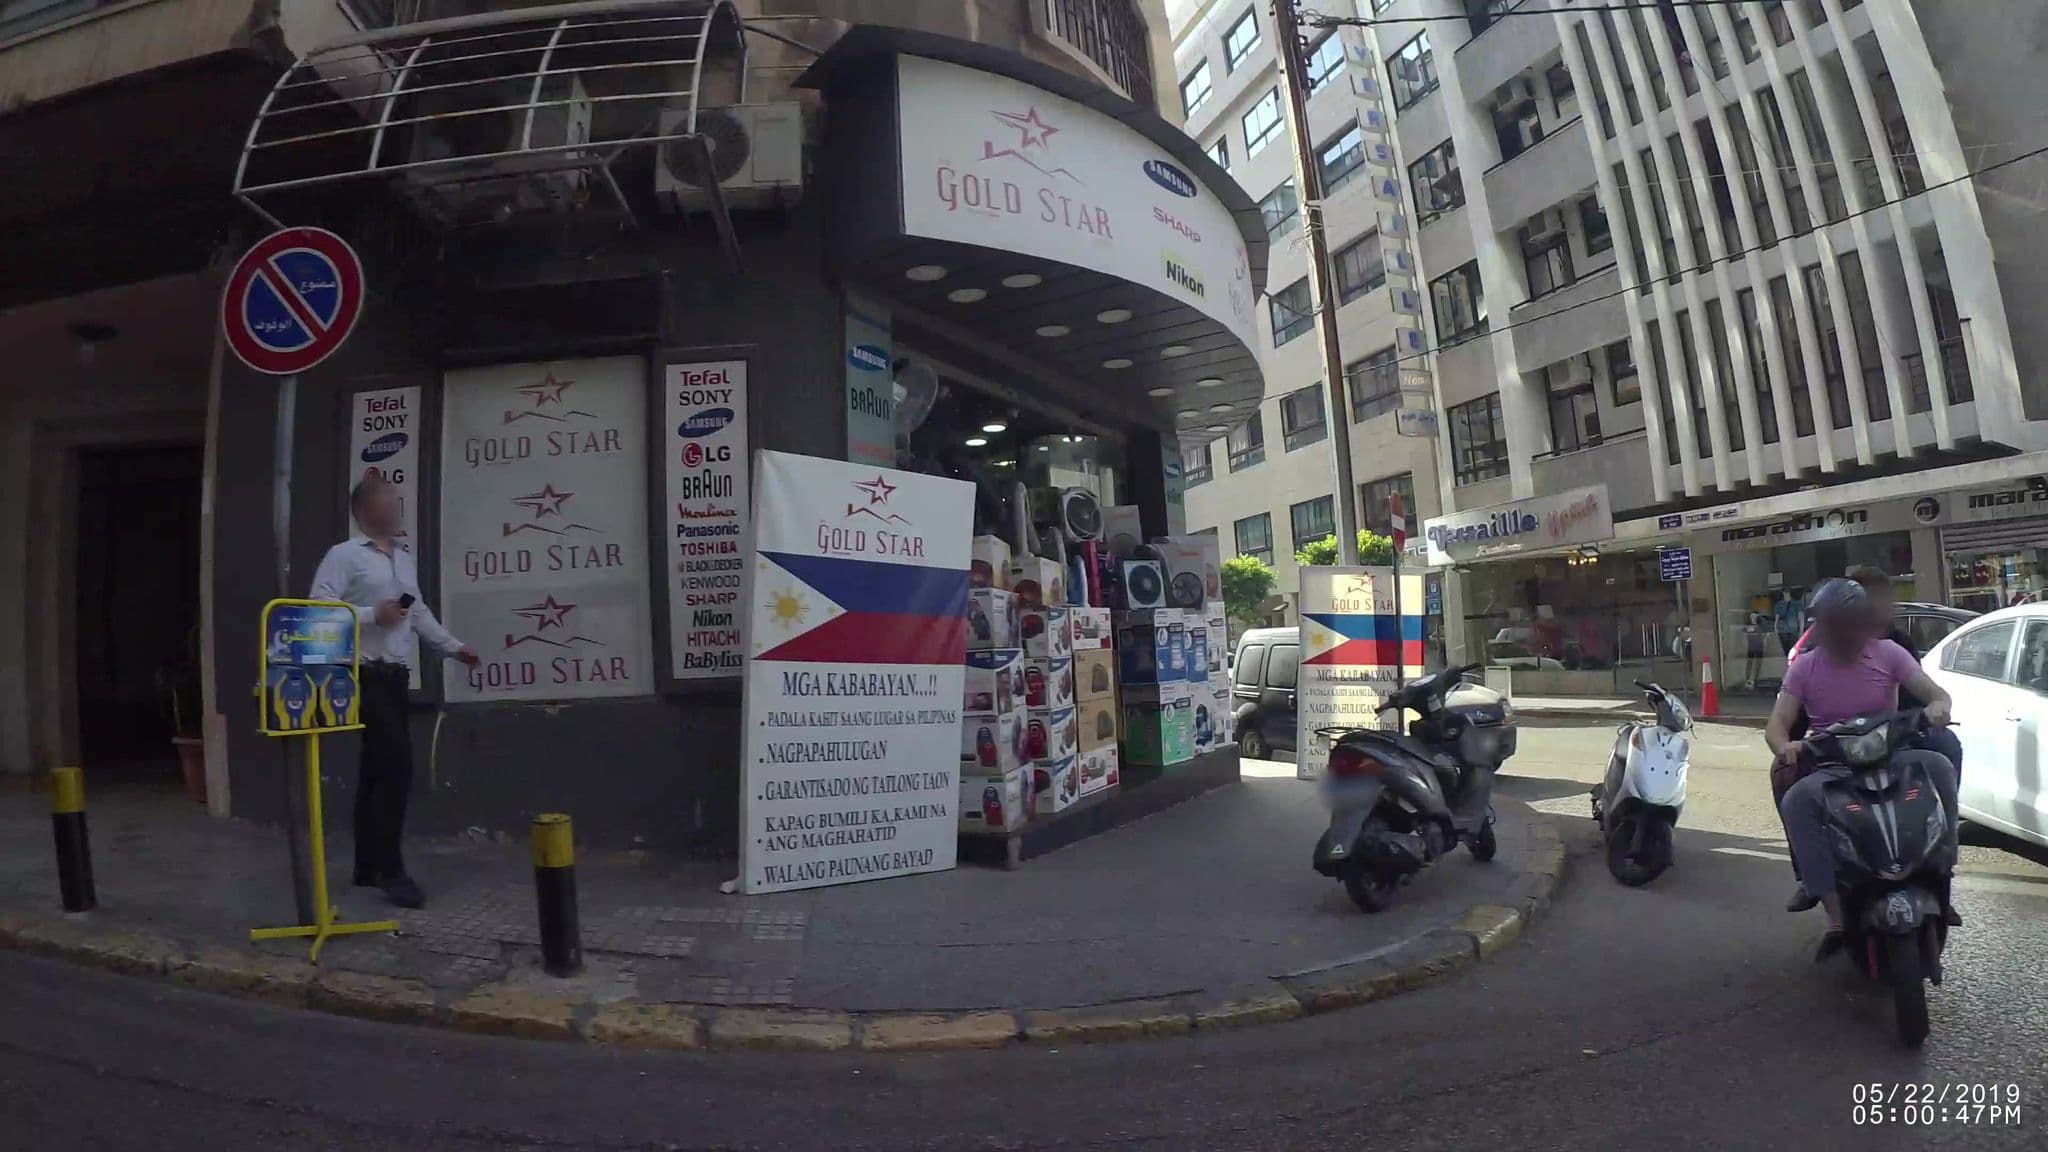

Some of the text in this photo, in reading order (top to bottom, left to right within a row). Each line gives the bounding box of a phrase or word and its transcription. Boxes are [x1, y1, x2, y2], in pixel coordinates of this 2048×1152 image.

[1150, 160, 1194, 197] SAMSUNG
[937, 166, 1113, 239] GOLD STAR
[1153, 207, 1201, 242] SHARP
[1166, 260, 1204, 296] Nikon
[680, 368, 730, 386] Tefal
[365, 395, 407, 413] Tefal
[679, 389, 733, 406] SONY
[850, 387, 890, 421] BRAUN
[363, 415, 409, 432] SONY
[685, 417, 728, 429] SAMSUNG
[465, 429, 622, 468] GOLD STAR
[705, 446, 731, 463] LG
[683, 468, 732, 499] BRAUN
[677, 521, 740, 538] Panasonic
[818, 524, 924, 557] GOLD STAR
[1428, 508, 1537, 550] Versaille
[680, 541, 737, 555] TOSHIBA
[465, 544, 623, 581] GOLD STAR
[681, 576, 740, 589] KENWOOD
[686, 592, 737, 606] SHARP
[1332, 598, 1360, 613] GOLD
[693, 609, 732, 628] Nikon
[687, 630, 740, 647] HITACHI
[683, 650, 743, 671] BaByliss
[468, 657, 629, 692] GOLD STAR
[782, 672, 821, 696] MGA
[768, 712, 807, 726] PADALA
[767, 740, 887, 763] NAGPAPAHULUGAN
[873, 773, 919, 794] TATLONG
[923, 771, 950, 790] TAON
[765, 814, 815, 832] KAPAG
[819, 811, 867, 828] BUMILI
[930, 803, 947, 818] NA
[765, 826, 896, 851] ANG MAGHAHATID
[765, 848, 933, 884] WALANG PAUNANG BAYAD
